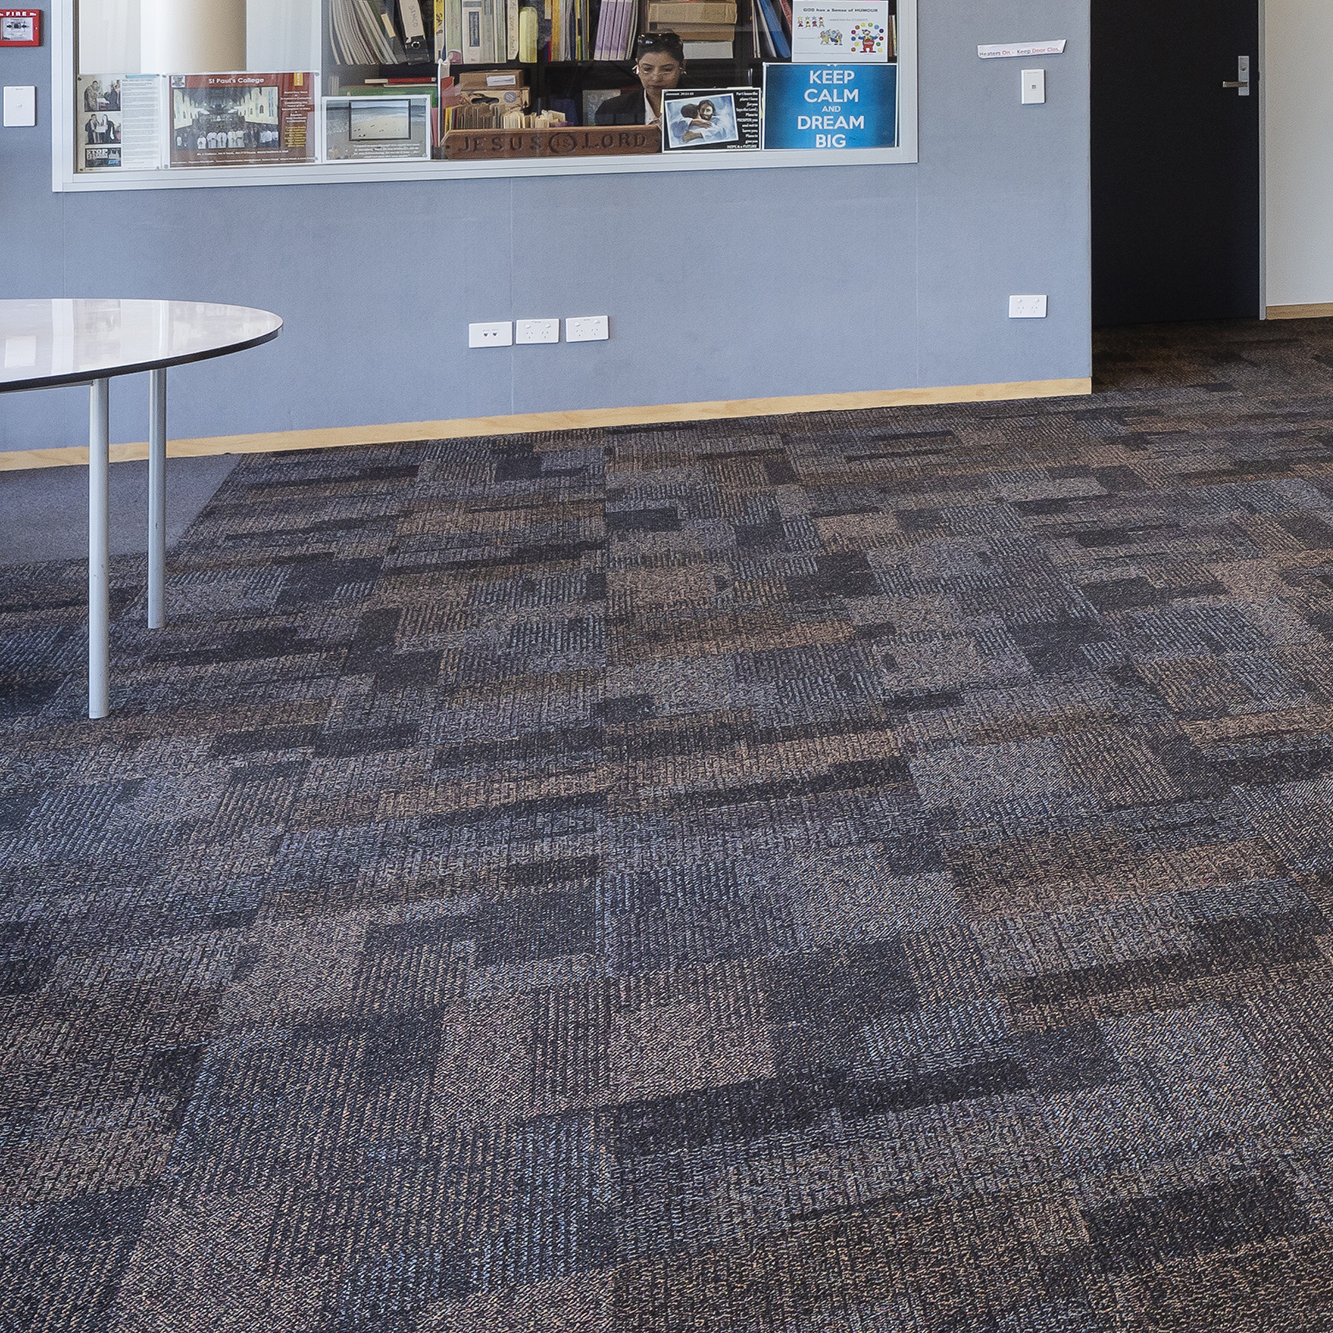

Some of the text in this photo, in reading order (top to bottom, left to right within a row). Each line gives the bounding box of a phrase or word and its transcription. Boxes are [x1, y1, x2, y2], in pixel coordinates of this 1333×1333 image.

[809, 70, 855, 84] KEEP
[804, 88, 859, 103] CALM
[821, 105, 841, 113] AND
[797, 115, 865, 130] DREAM
[458, 136, 542, 152] JESUS
[581, 133, 647, 149] LORD
[815, 134, 847, 149] BIG
